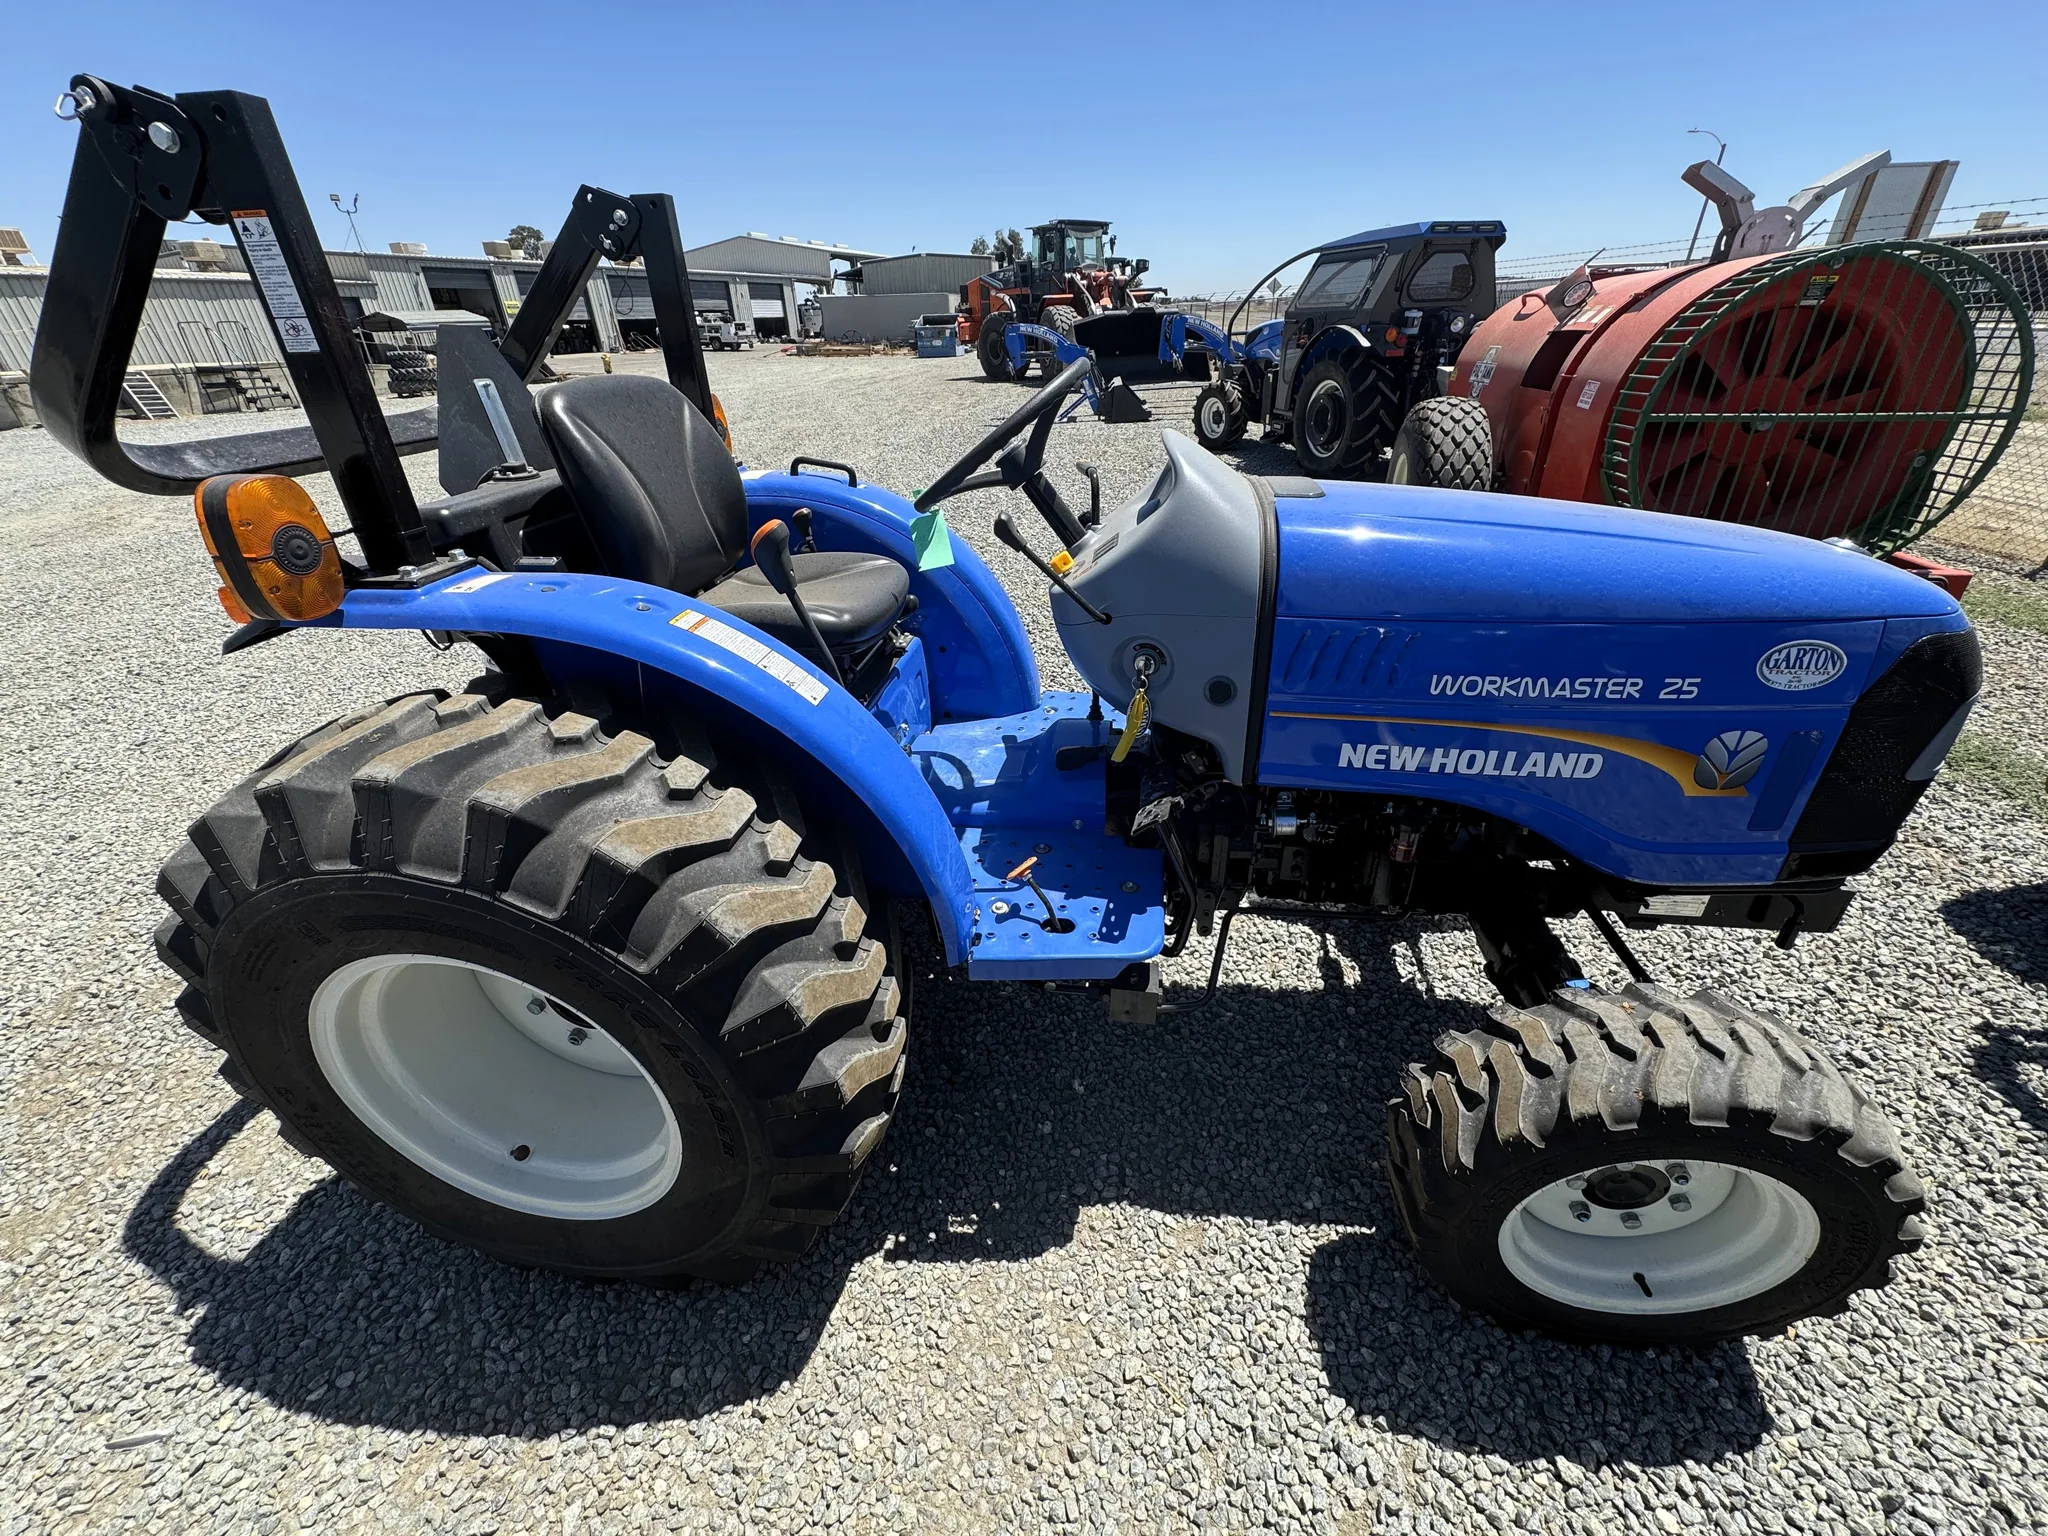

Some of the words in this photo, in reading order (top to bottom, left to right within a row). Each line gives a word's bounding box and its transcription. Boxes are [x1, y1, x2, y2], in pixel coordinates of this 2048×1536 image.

[1187, 317, 1200, 325] NEW
[1200, 320, 1224, 338] HOLLAND
[1765, 648, 1839, 671] GARTON
[1430, 674, 1643, 699] WORKMASTER
[1658, 677, 1702, 699] 25
[1338, 742, 1426, 771] NEW
[1429, 748, 1603, 779] HOLLAND
[660, 1041, 736, 1159] LOADER
